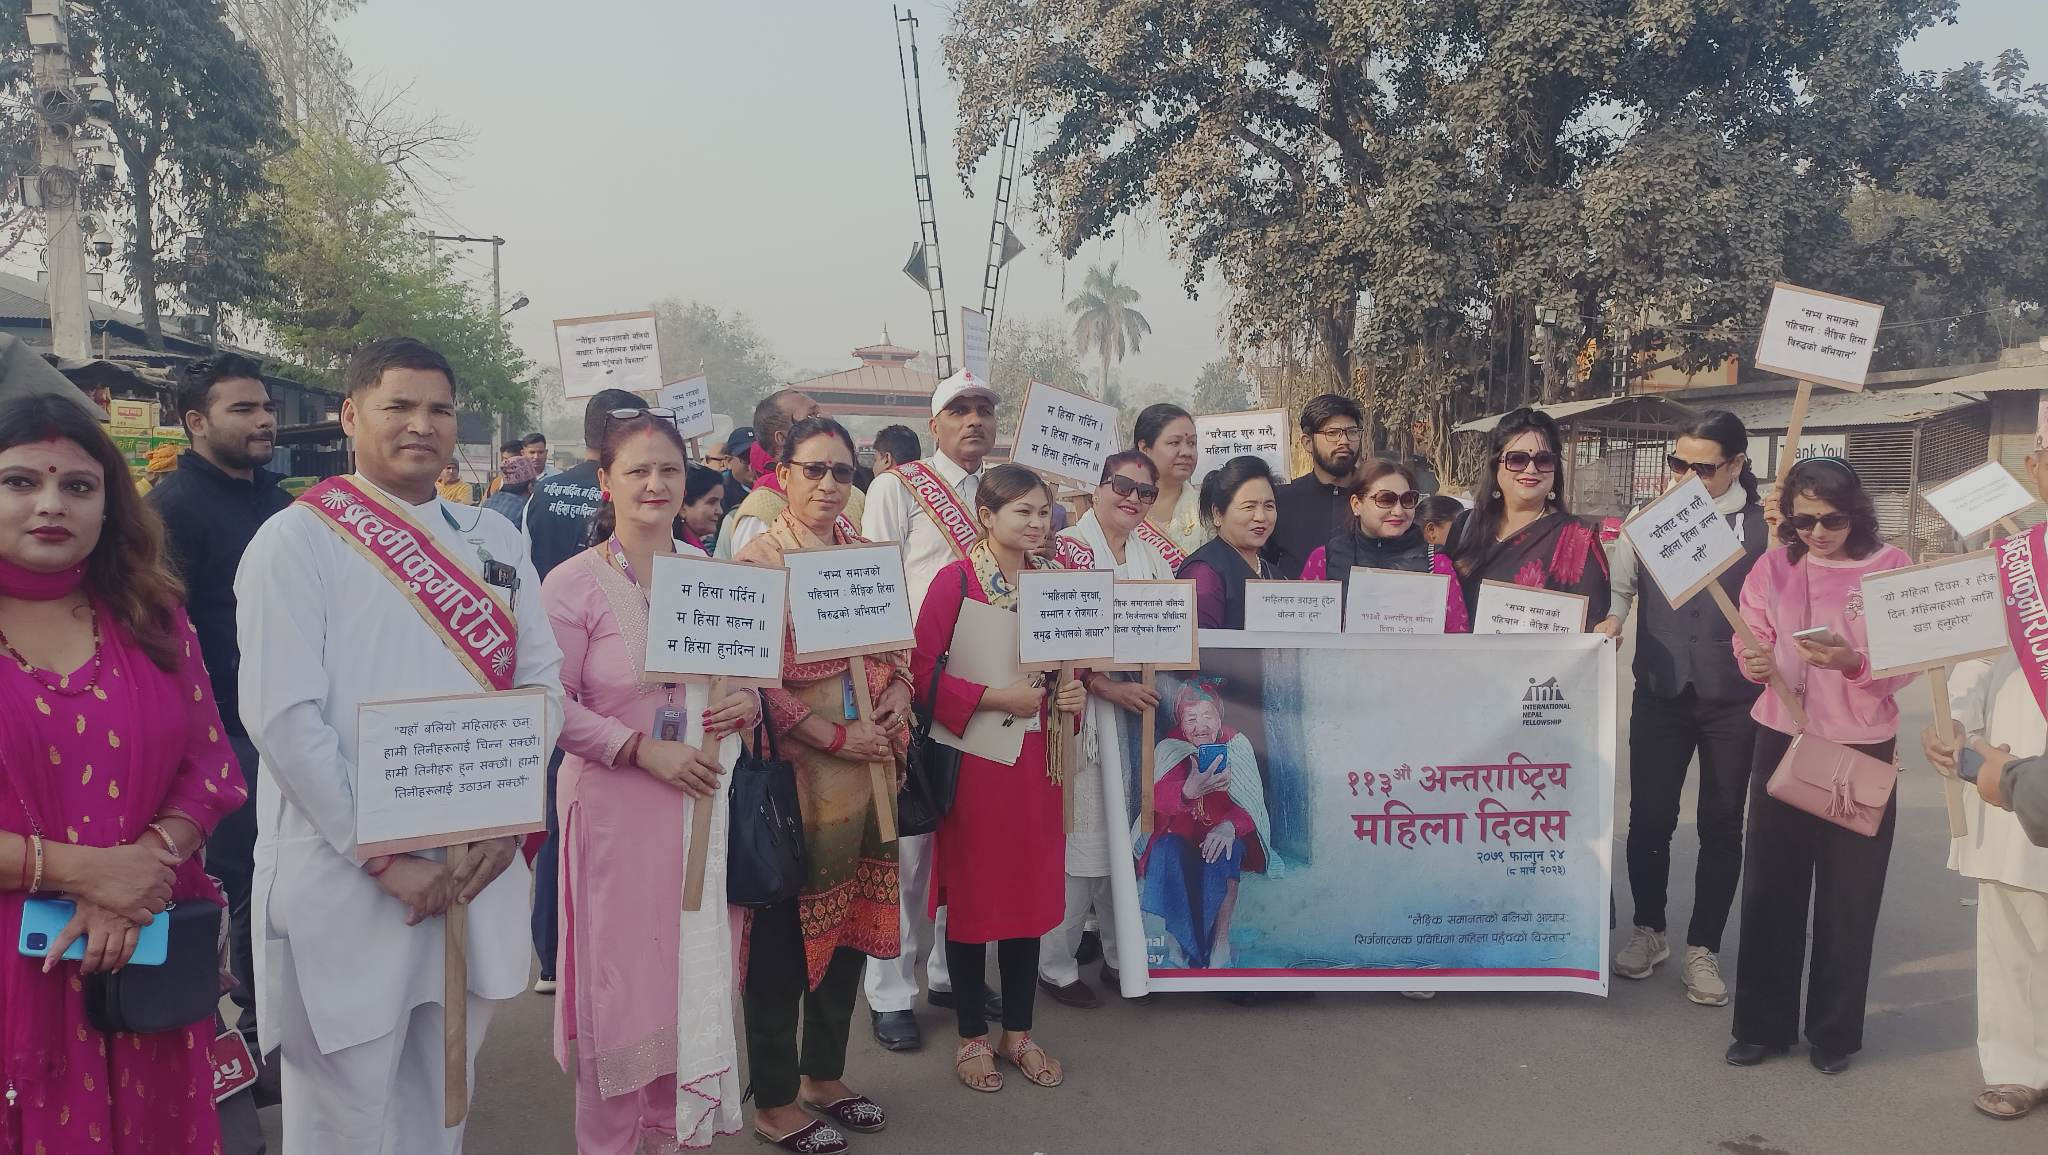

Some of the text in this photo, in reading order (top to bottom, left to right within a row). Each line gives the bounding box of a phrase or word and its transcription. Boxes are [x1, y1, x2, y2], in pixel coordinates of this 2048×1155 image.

[1047, 405, 1056, 416] म
[1041, 425, 1049, 436] म
[1031, 443, 1040, 454] म
[1205, 444, 1231, 456] महिला
[1821, 443, 1843, 459] You
[1659, 538, 1683, 559] महिला
[846, 564, 880, 578] समाजको
[681, 584, 692, 597] म
[698, 581, 723, 599] हिंसा
[807, 588, 840, 600] पहिचान
[1900, 586, 1930, 599] महिला
[676, 611, 687, 624] म
[693, 609, 720, 627] हिंसा
[726, 616, 754, 630] सहन्न
[1039, 609, 1064, 619] सम्मान
[1066, 609, 1072, 618] र
[1055, 627, 1082, 639] नेपालको
[667, 639, 678, 652] म
[684, 636, 711, 654] हिंसा
[1522, 711, 1543, 719] NEPAL
[424, 719, 457, 734] बलियो
[384, 744, 408, 760] हामी
[384, 765, 409, 781] हामी
[518, 754, 540, 769] हामी
[1351, 797, 1572, 850] महिला दिवस
[1476, 849, 1565, 865] २०७९ फाल्गुन २४
